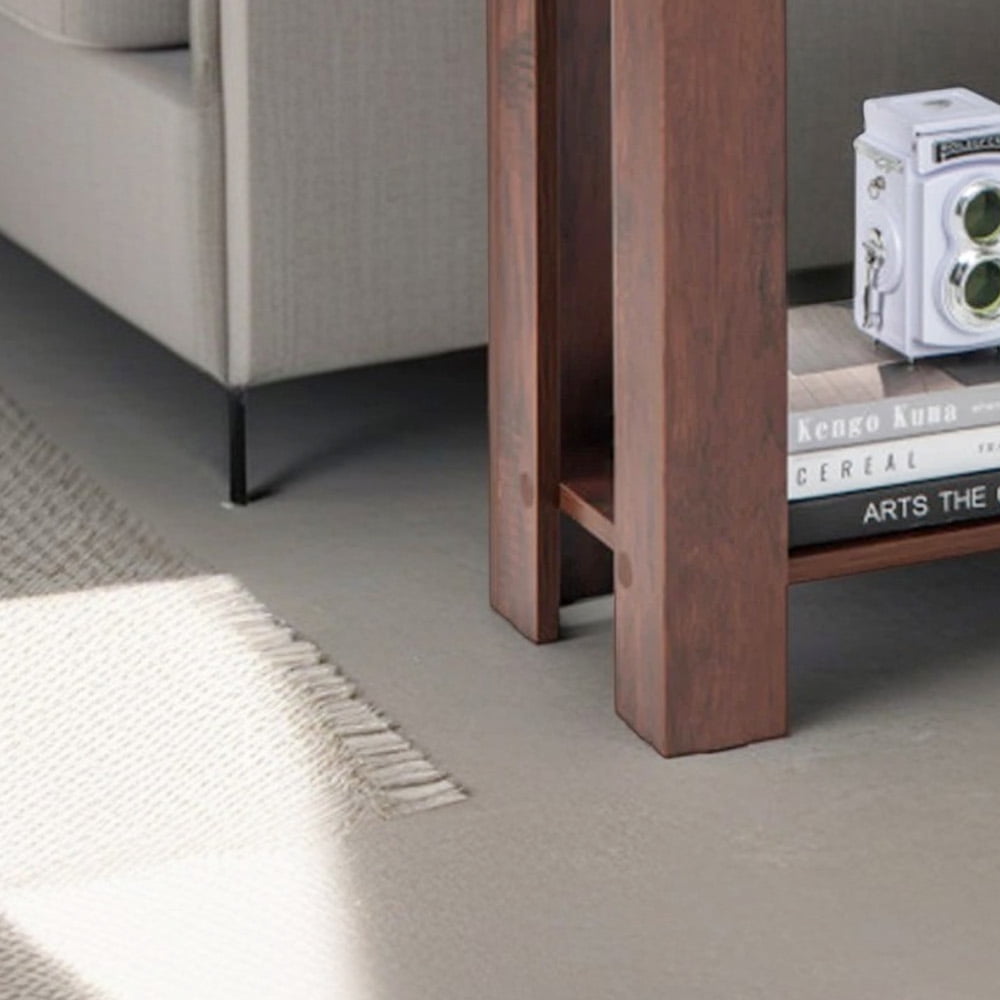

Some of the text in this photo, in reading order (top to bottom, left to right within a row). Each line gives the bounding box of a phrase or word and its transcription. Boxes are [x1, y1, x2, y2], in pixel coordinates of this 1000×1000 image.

[796, 412, 880, 443] Kengo
[892, 402, 958, 429] Kuma
[796, 451, 917, 486] CEREAL
[863, 495, 929, 524] ARTS
[939, 486, 987, 513] THE
